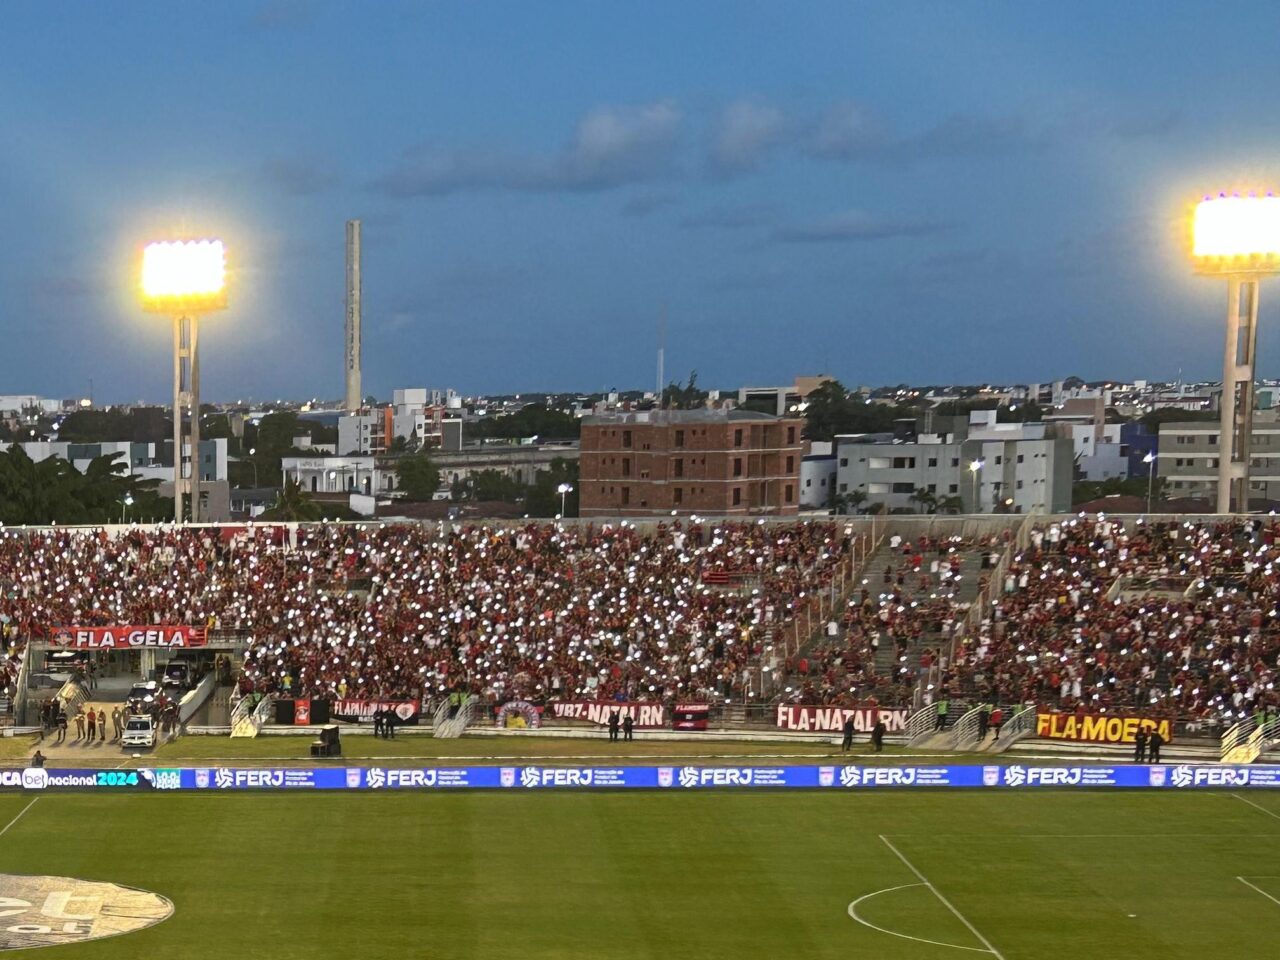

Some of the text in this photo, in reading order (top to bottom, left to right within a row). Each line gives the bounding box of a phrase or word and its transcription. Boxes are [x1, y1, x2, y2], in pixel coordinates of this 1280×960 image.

[76, 631, 115, 647] FLA
[128, 631, 185, 647] GELA
[48, 773, 97, 786] nacional
[97, 771, 139, 786] 2024
[235, 770, 284, 786] FERJ
[387, 770, 437, 786] FERJ
[542, 769, 592, 785] FERJ
[701, 768, 753, 785] FERJ
[862, 767, 916, 785] FERJ
[1026, 767, 1082, 784] FERJ
[1194, 767, 1250, 785] FERJ
